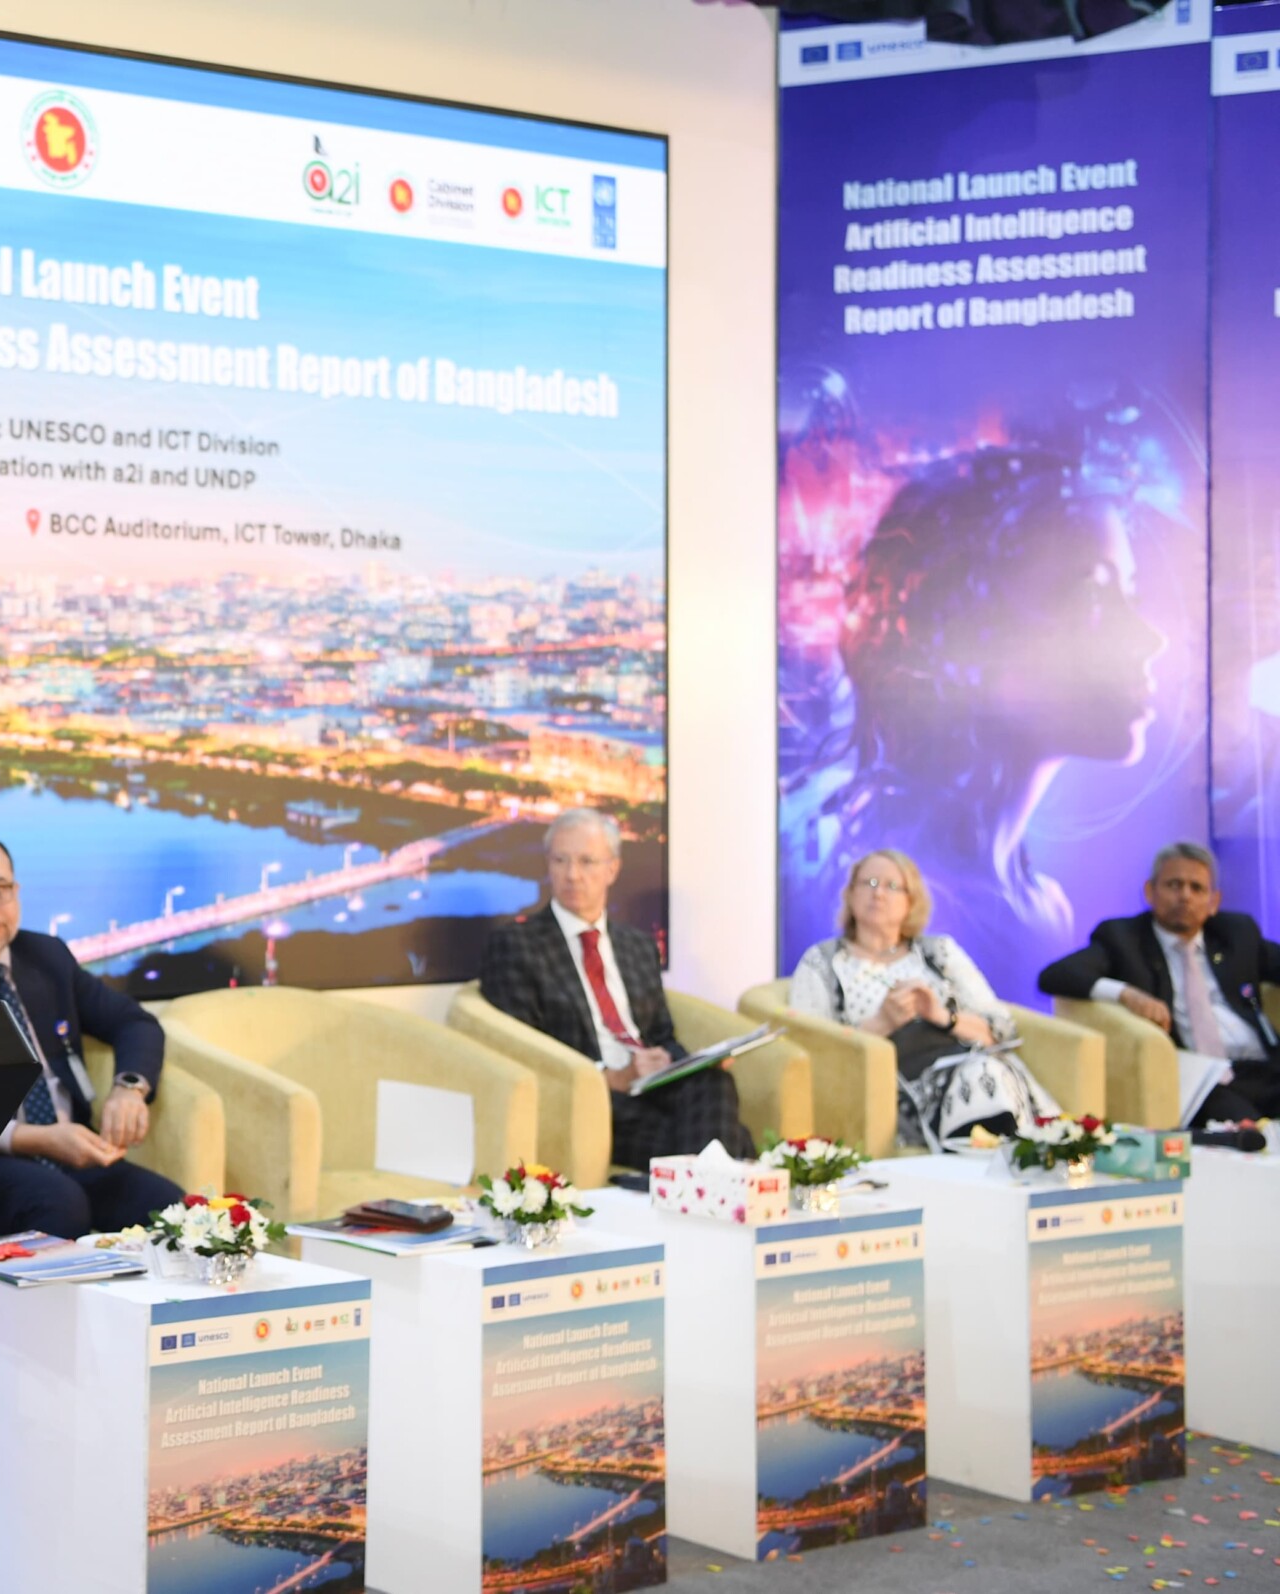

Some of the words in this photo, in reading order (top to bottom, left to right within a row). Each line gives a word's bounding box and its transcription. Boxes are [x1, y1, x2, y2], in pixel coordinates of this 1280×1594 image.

[535, 185, 571, 214] ICT
[843, 172, 954, 210] National
[958, 164, 1057, 201] Launch
[1061, 158, 1138, 192] Event
[844, 214, 961, 252] Artificial
[964, 205, 1134, 243] Intelligence
[21, 248, 156, 310] Launch
[162, 264, 260, 321] Event
[833, 260, 973, 294] Readiness
[976, 245, 1147, 284] Assessment
[844, 302, 934, 335] Report
[937, 298, 966, 329] of
[969, 288, 1135, 327] Bangladesh
[46, 322, 271, 390] Assessment
[277, 343, 391, 400] Report
[396, 357, 430, 402] of
[435, 358, 619, 418] Bangladesh
[8, 419, 106, 445] UNESCO
[113, 428, 152, 448] and
[158, 429, 192, 450] ICT
[197, 432, 279, 455] Division
[60, 459, 106, 481] with
[113, 463, 143, 483] a2i
[150, 467, 188, 487] and
[194, 467, 256, 490] UNDP
[49, 513, 97, 536] BCC
[103, 517, 229, 545] Auditorium,
[234, 522, 266, 543] ICT
[273, 525, 336, 549] Tower,
[340, 528, 402, 551] Dhaka
[198, 1374, 247, 1396] National
[249, 1368, 290, 1388] Launch
[292, 1365, 323, 1381] Event
[165, 1403, 217, 1424] Artificial
[219, 1393, 289, 1415] Intelligence
[291, 1384, 350, 1406] Readiness
[161, 1423, 233, 1449] Assessment
[235, 1417, 274, 1438] Report
[275, 1414, 287, 1430] of
[289, 1405, 356, 1429] Bangladesh
